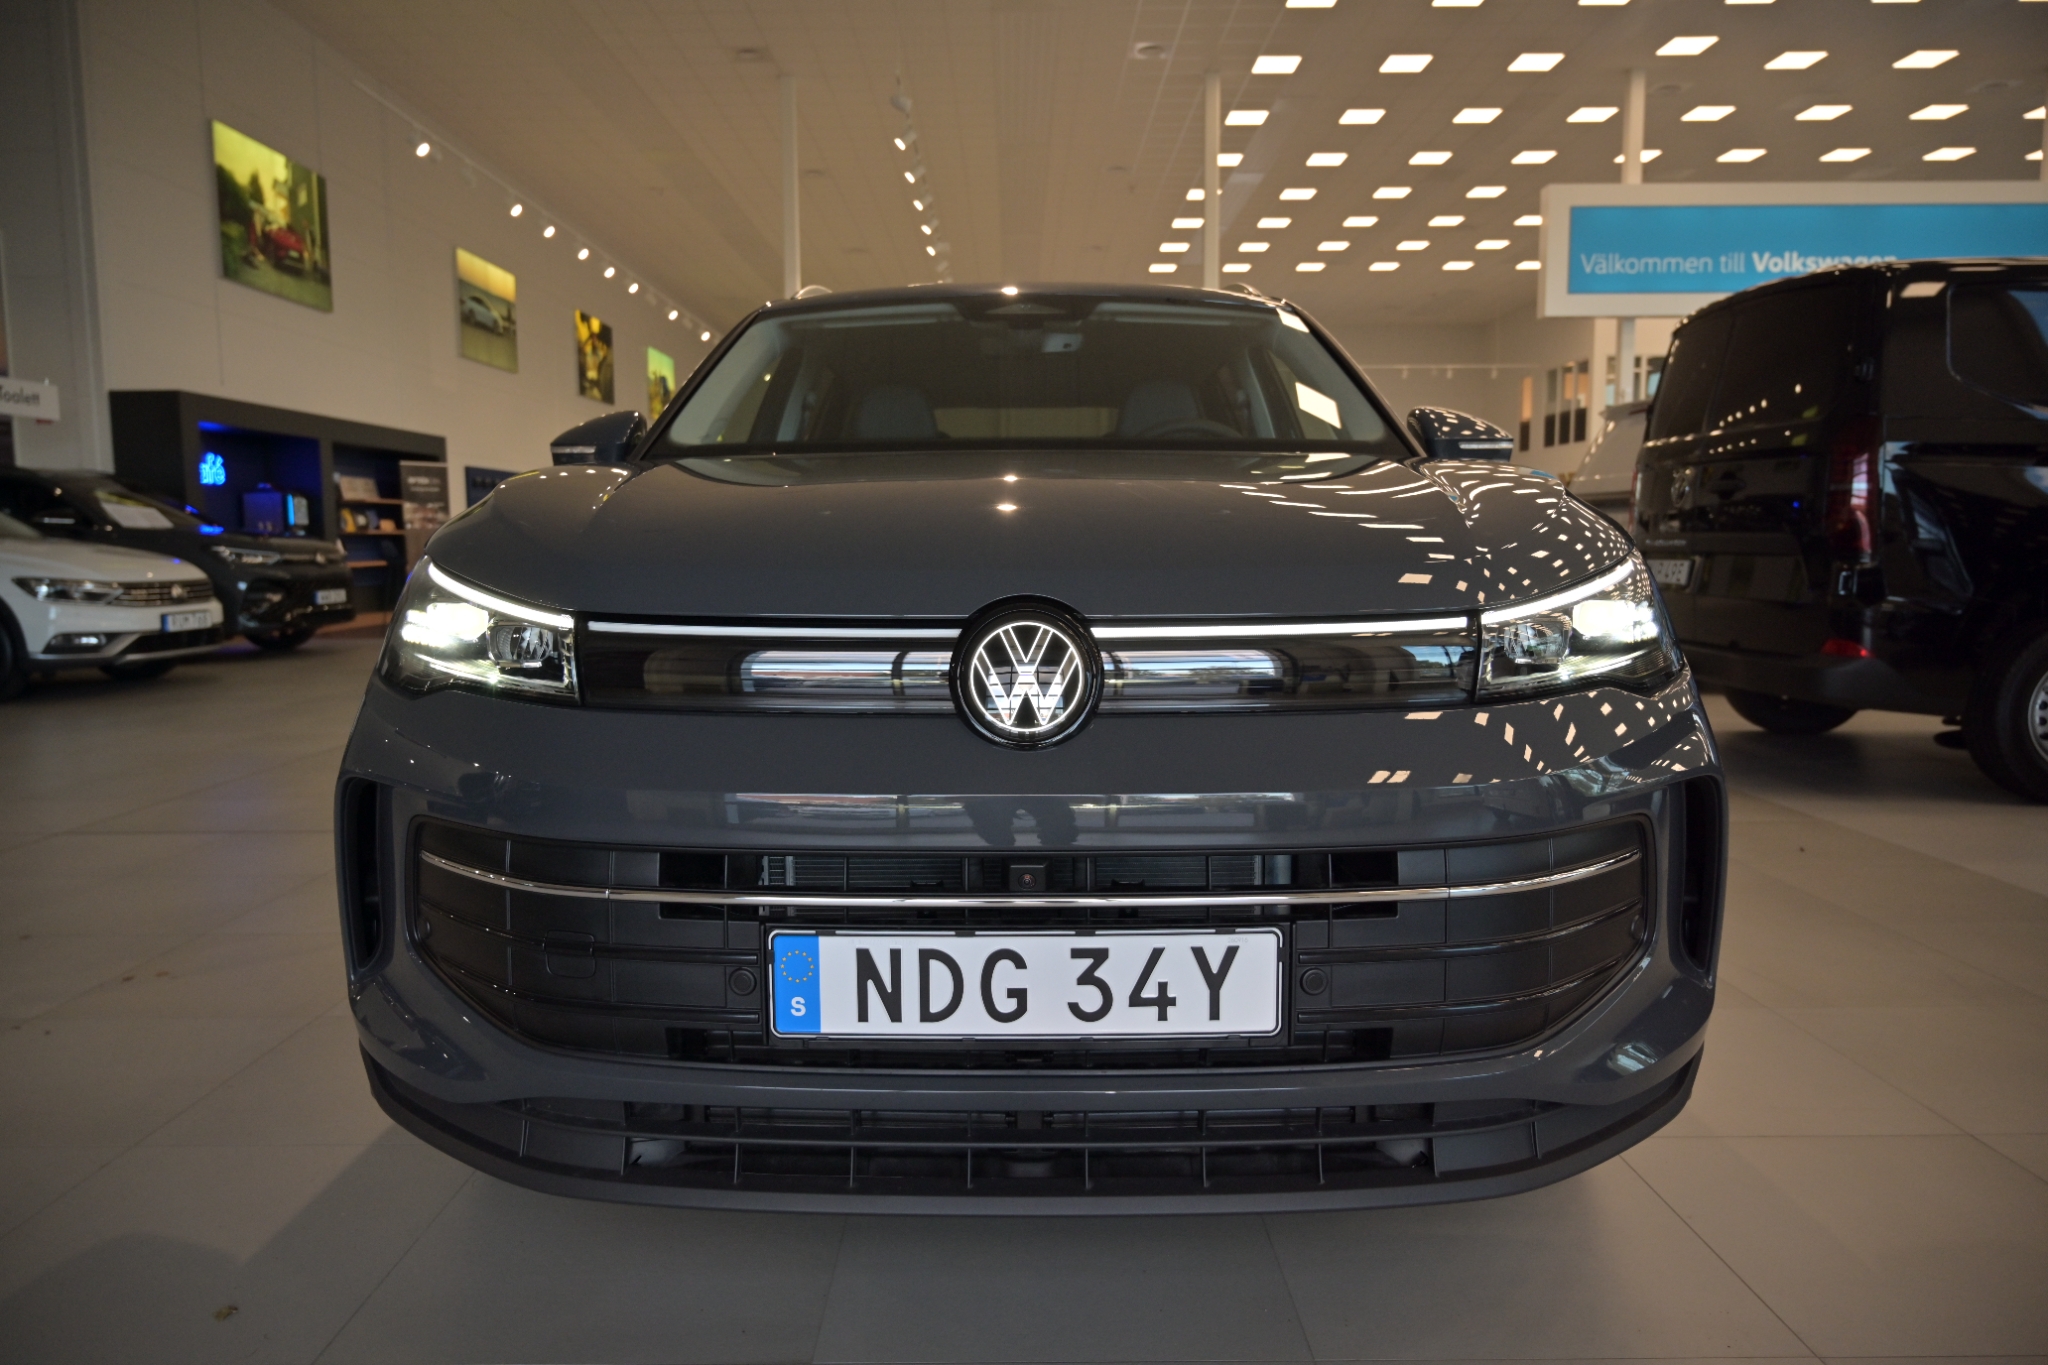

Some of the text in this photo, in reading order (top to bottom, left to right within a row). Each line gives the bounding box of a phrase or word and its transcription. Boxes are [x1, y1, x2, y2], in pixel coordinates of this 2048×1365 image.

[1580, 250, 1898, 274] Välkommen till Volksw
[199, 451, 226, 485] afé
[855, 945, 1241, 1024] NDG 34Y
[790, 996, 806, 1017] S
